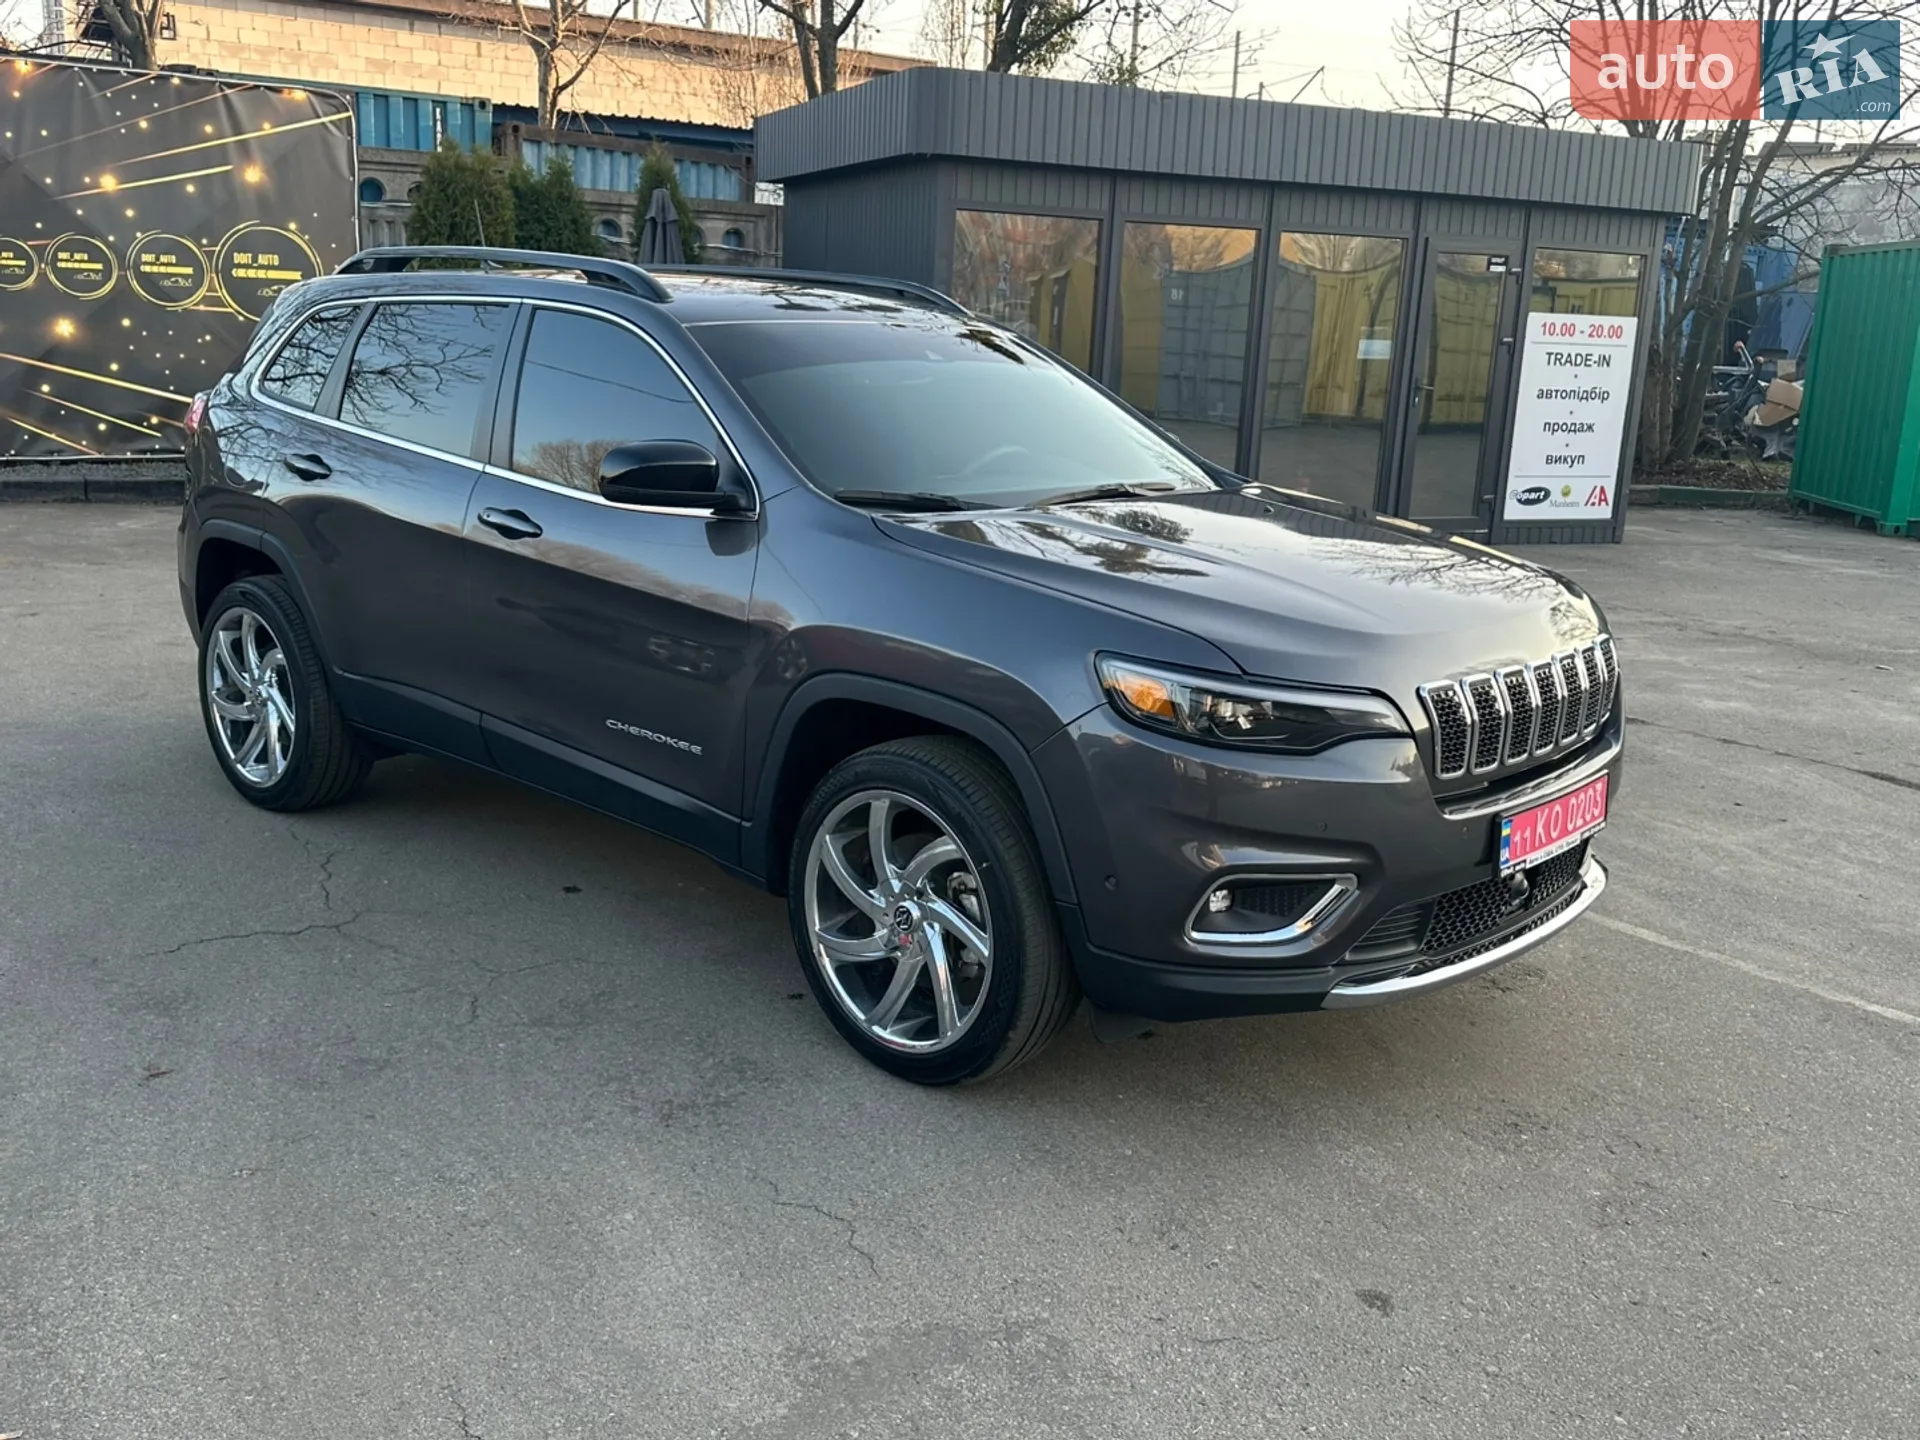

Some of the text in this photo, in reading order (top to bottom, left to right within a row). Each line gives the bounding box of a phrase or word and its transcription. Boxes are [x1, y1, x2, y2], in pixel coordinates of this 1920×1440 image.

[233, 252, 280, 267] DOIT_AUTO
[1541, 321, 1576, 337] 10.00
[1588, 323, 1624, 339] 20.00
[1545, 352, 1611, 368] TRADE-IN
[1536, 386, 1610, 404] автопідбір
[1543, 420, 1595, 435] продаж
[1545, 454, 1585, 470] викуп
[1509, 489, 1545, 501] Copart
[605, 719, 702, 755] CHEROKEE
[1567, 781, 1603, 832] 0203
